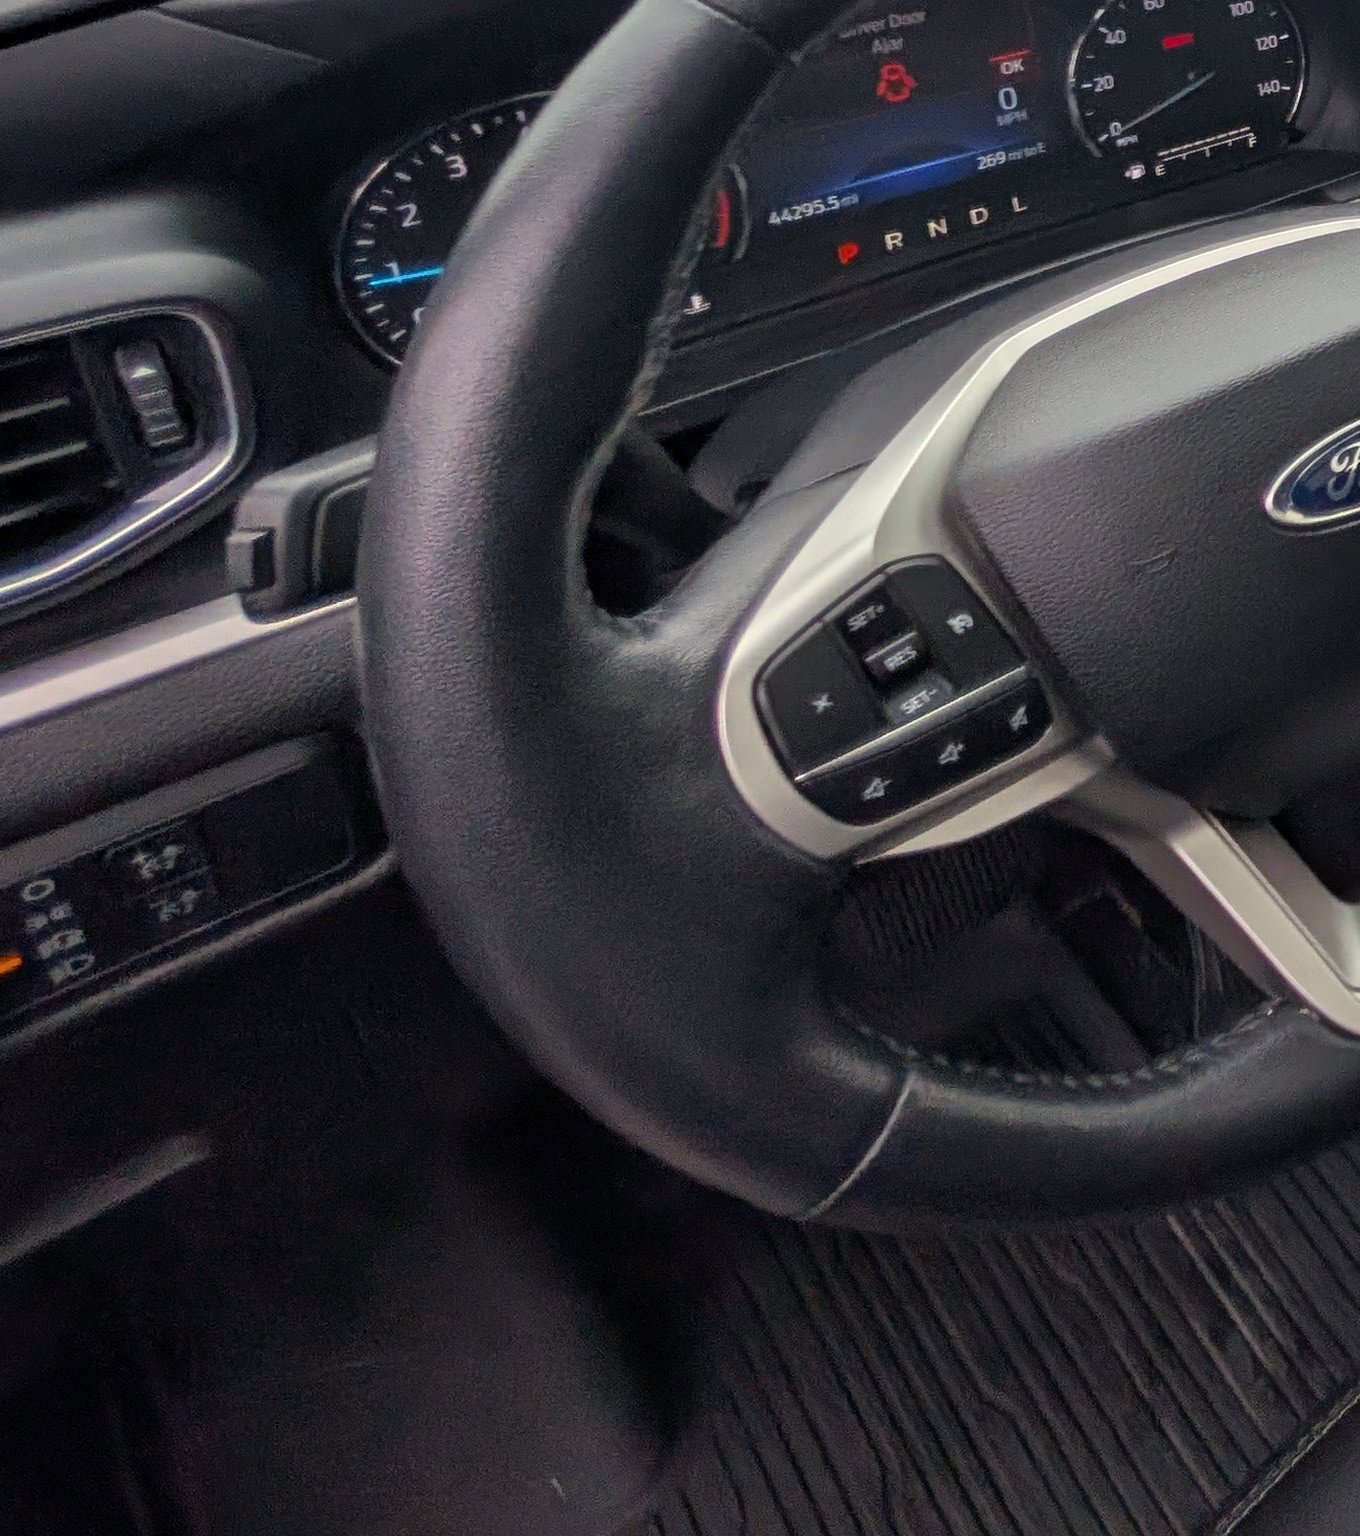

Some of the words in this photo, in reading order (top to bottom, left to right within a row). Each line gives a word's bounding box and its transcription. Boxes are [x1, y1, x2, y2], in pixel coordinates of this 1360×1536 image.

[1229, 0, 1255, 17] 100
[1105, 29, 1127, 45] 40
[1256, 35, 1278, 52] 120
[999, 58, 1025, 75] OK
[1093, 74, 1115, 93] 20
[1257, 80, 1281, 97] 140
[998, 86, 1018, 110] 0
[1109, 121, 1123, 137] 0
[445, 154, 468, 179] 3
[976, 150, 1007, 170] 269
[1154, 164, 1166, 177] E
[396, 203, 421, 228] 2
[768, 195, 840, 225] 44295.5
[838, 241, 860, 264] P
[884, 231, 903, 250] R
[927, 219, 948, 238] N
[969, 207, 989, 225] D
[1011, 197, 1028, 213] L
